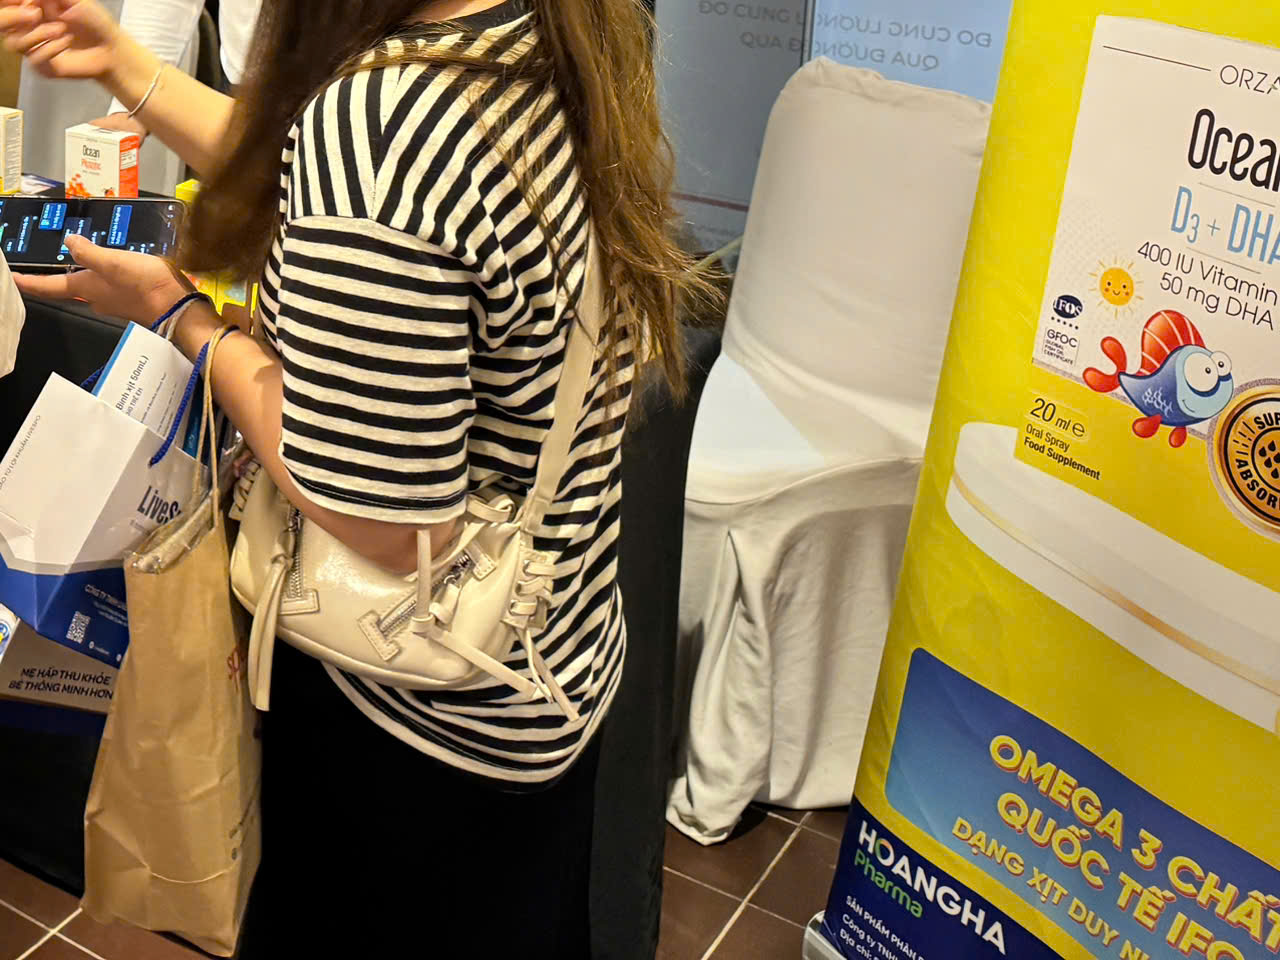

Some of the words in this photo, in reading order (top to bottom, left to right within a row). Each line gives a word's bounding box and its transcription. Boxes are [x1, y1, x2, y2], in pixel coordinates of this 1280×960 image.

[1137, 241, 1172, 266] 400
[1175, 253, 1194, 274] IU
[1200, 260, 1278, 307] Vitamin
[1160, 271, 1183, 295] 50
[1186, 286, 1220, 314] mg
[1225, 296, 1274, 331] DHA
[1047, 328, 1078, 348] GFOC
[1030, 397, 1056, 423] 20
[1055, 417, 1071, 431] ml
[1024, 436, 1046, 454] Food
[1047, 447, 1101, 481] Supplement
[1026, 423, 1043, 439] Oral
[1045, 431, 1070, 453] Spray
[137, 485, 182, 525] LiveS
[1235, 458, 1280, 511] ABSOR
[59, 670, 80, 681] THU
[61, 685, 90, 696] MINH
[989, 735, 1123, 851] OMEGA
[1131, 828, 1163, 871] 3
[854, 848, 924, 919] Pharma
[952, 816, 1025, 876] DẠNG
[1026, 867, 1069, 905] XỊT
[1068, 897, 1120, 947] DUY
[997, 792, 1111, 890] QUỐC
[1117, 871, 1177, 933] TẾ
[858, 819, 1006, 955] HOANGHA
[840, 928, 855, 947] Địa
[867, 934, 876, 948] ty
